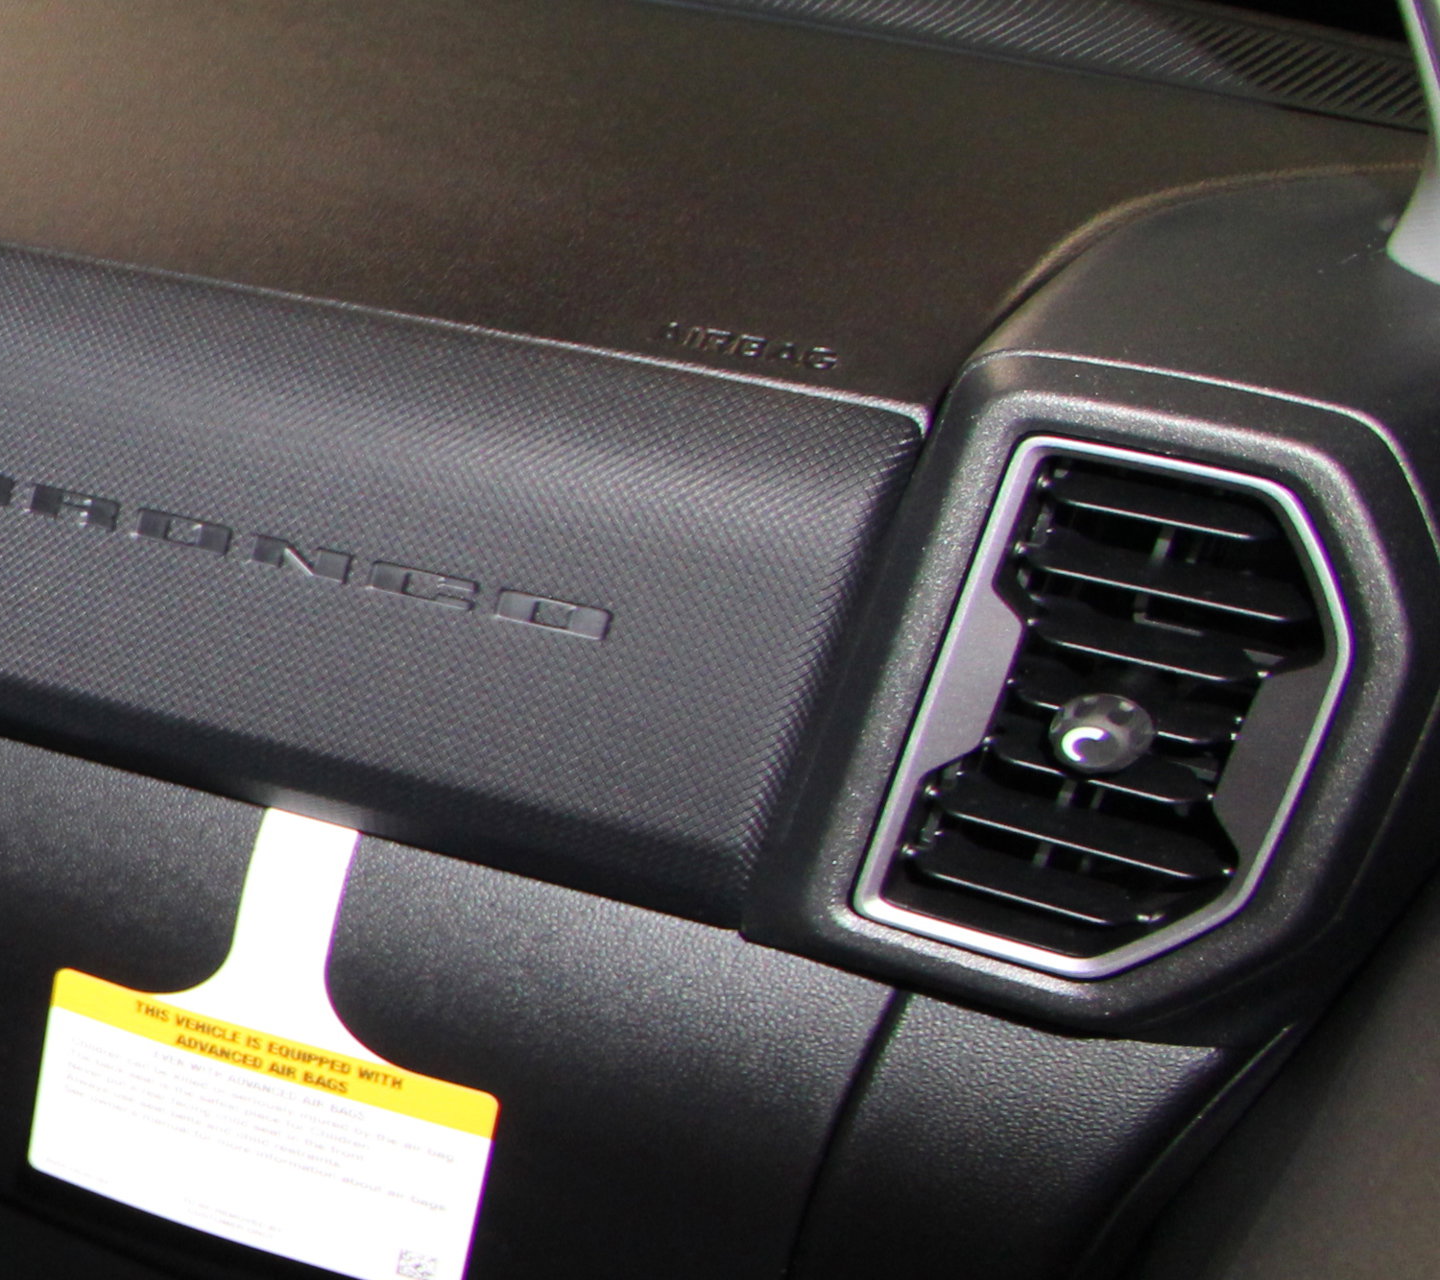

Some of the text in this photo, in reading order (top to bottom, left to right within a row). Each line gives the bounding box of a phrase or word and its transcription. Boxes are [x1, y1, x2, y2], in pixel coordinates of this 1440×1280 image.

[656, 321, 839, 370] AIRBAG
[133, 1000, 403, 1091] THIS VEHICLE IS EQUIPPED WITH
[175, 1033, 347, 1094] ADVANCED AIR BAGS
